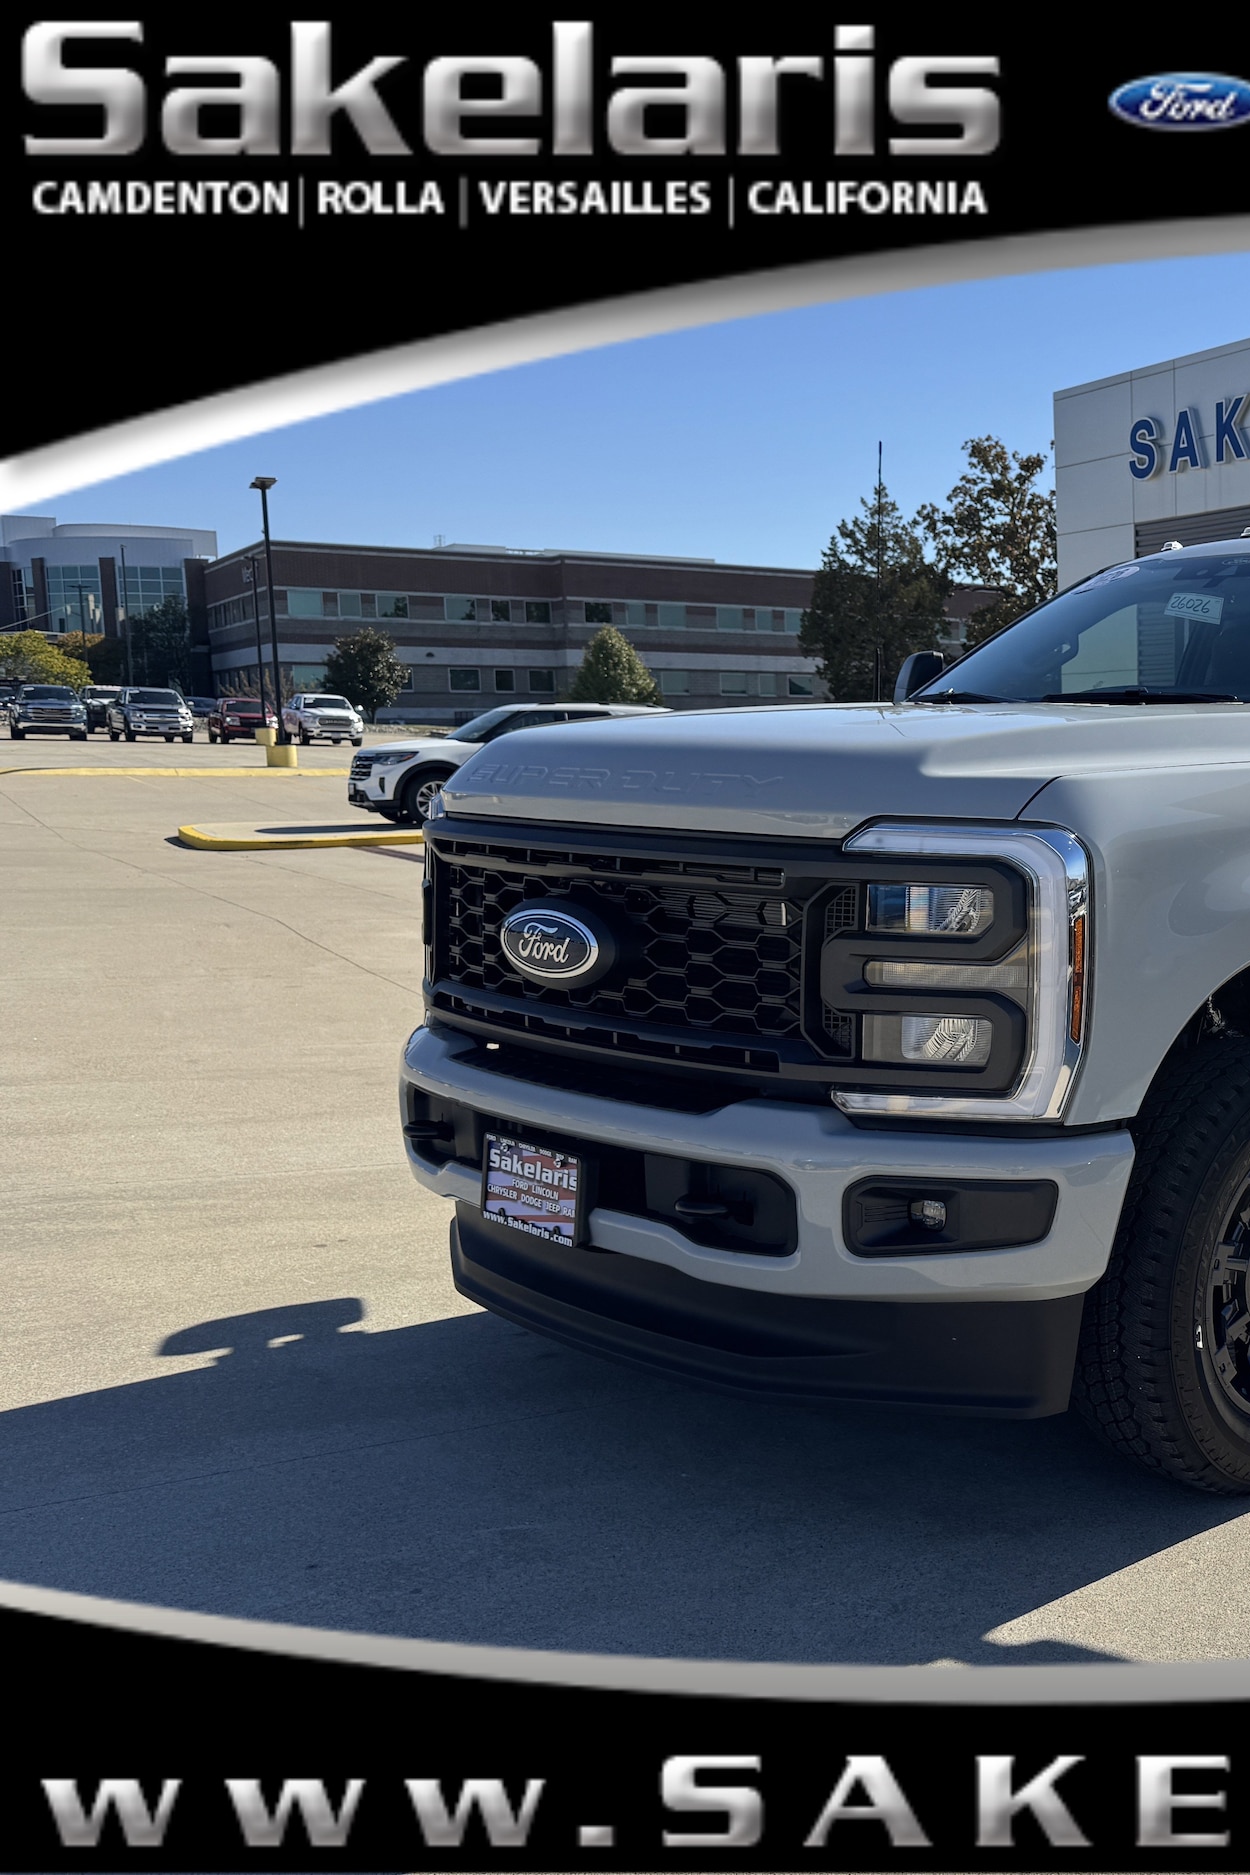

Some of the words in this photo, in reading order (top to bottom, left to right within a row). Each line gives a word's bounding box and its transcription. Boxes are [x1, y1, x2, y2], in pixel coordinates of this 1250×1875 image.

[1170, 595, 1211, 614] 26026
[467, 763, 611, 789] SUPER
[620, 769, 784, 796] DUTY
[518, 922, 570, 963] Ford
[489, 1148, 578, 1192] Sakelaris
[487, 1183, 518, 1200] CHRYSLER
[521, 1193, 542, 1208] DODGE
[545, 1201, 560, 1214] JEEP
[512, 1178, 528, 1191] FORD
[532, 1185, 559, 1200] LINCOLN
